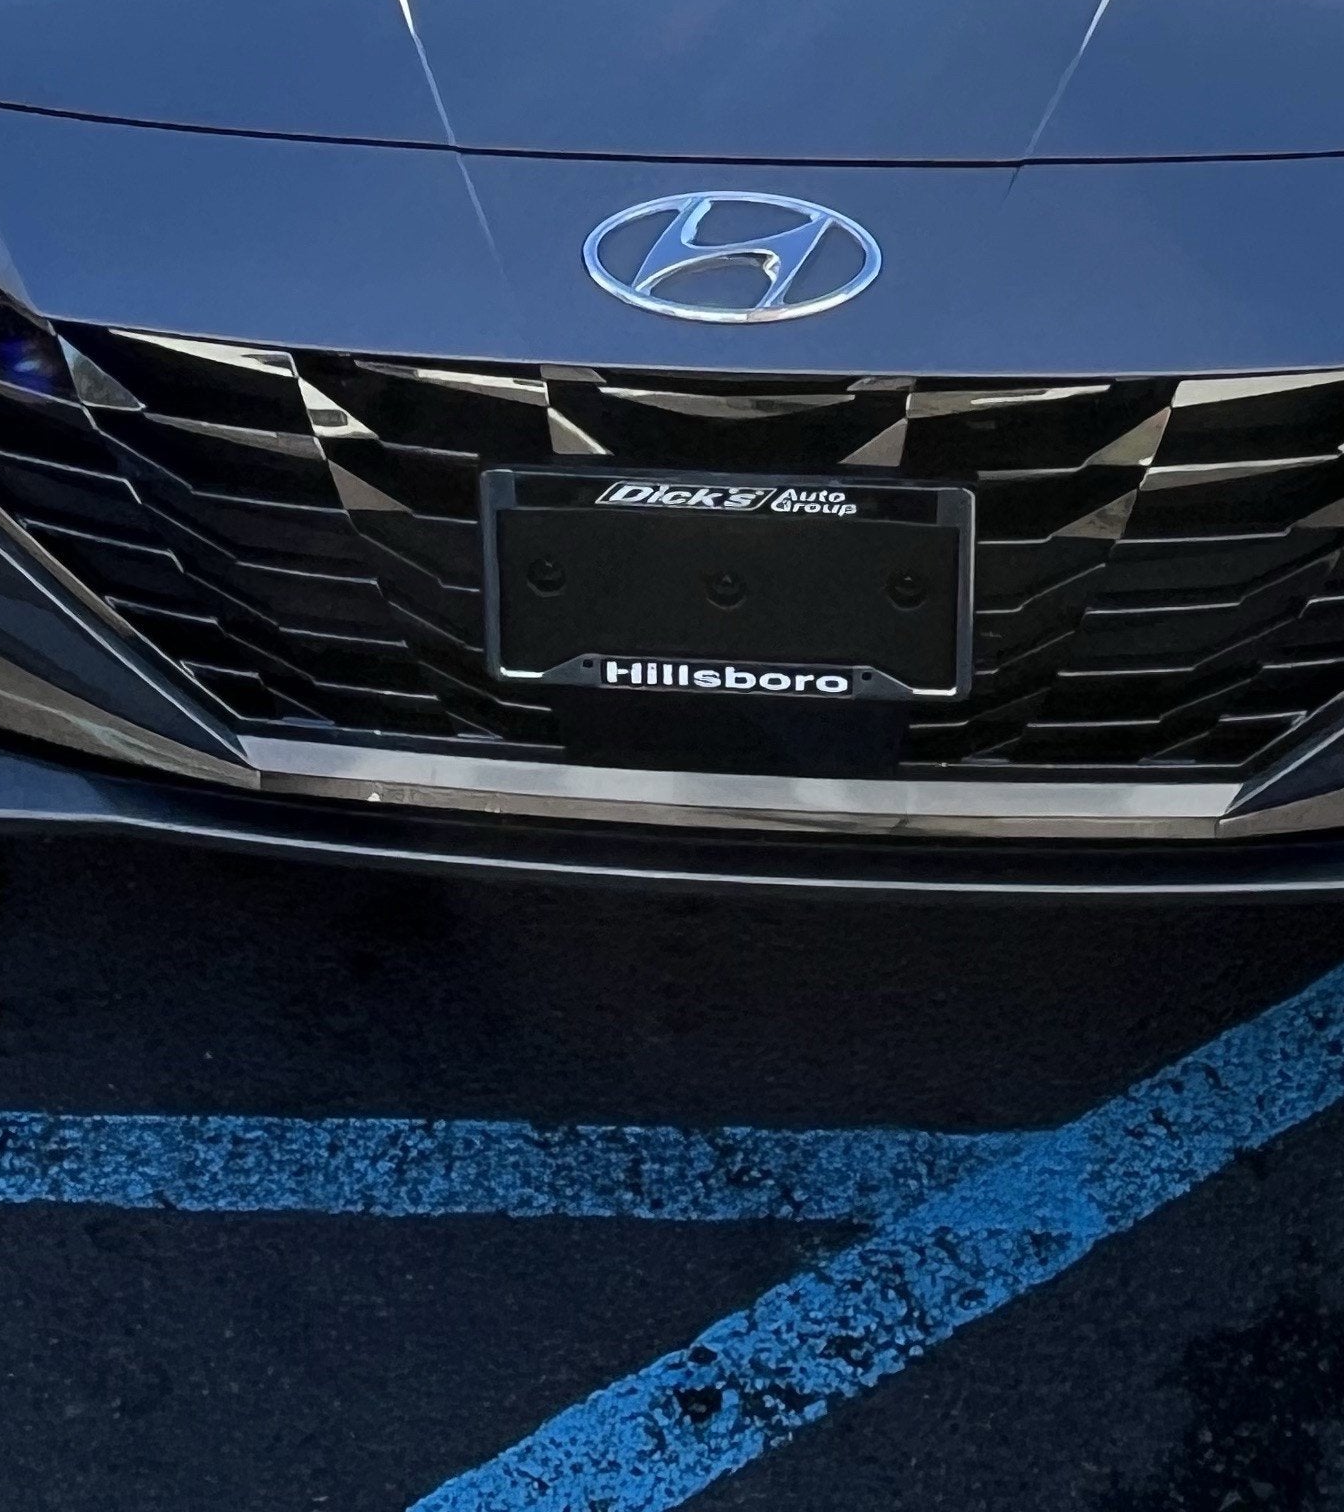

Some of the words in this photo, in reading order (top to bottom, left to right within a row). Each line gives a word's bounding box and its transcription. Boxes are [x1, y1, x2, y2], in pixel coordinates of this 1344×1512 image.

[781, 488, 846, 502] Auto
[771, 498, 857, 516] Group
[606, 661, 849, 693] Hillsboro
